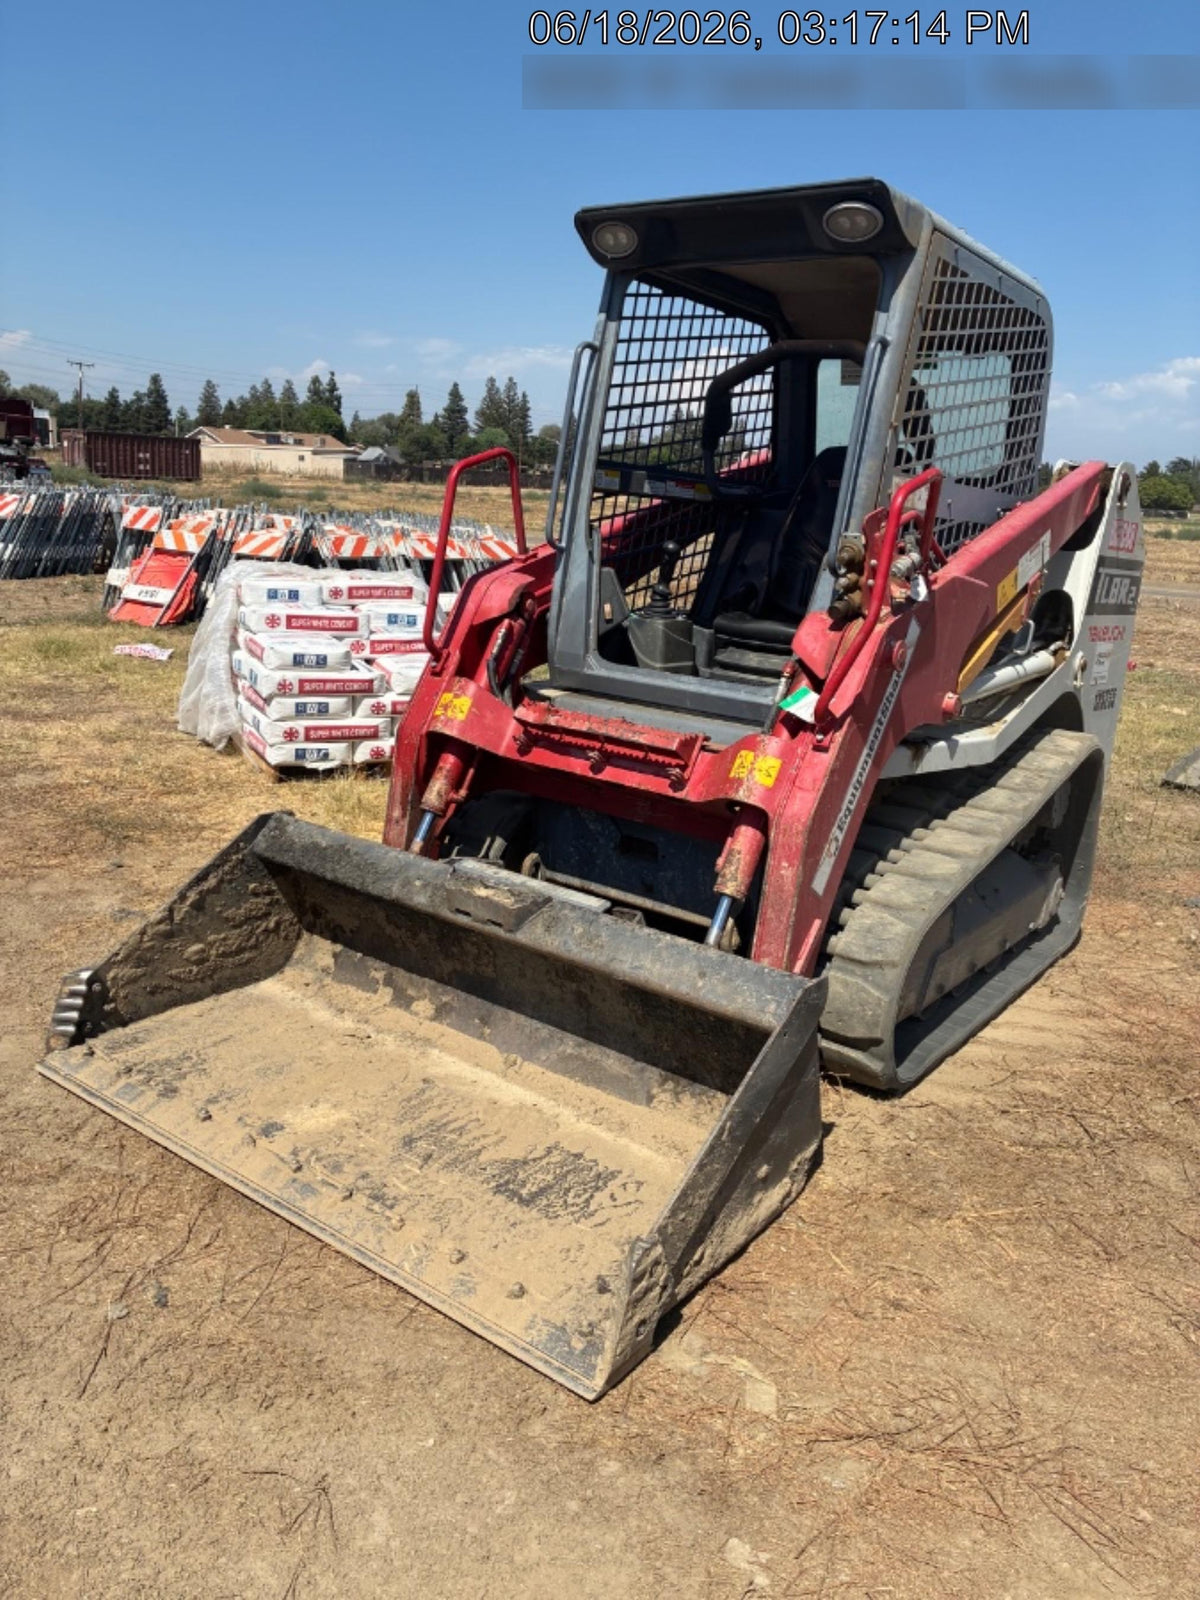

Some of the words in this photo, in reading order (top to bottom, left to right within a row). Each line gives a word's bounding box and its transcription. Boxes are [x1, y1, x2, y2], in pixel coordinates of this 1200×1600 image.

[291, 618, 310, 627] SUPER
[310, 619, 331, 628] WHITE
[331, 620, 354, 628] CEMENT
[303, 682, 324, 691] SUPER
[324, 682, 344, 691] WHITE
[344, 682, 369, 690] CEMENT
[310, 730, 330, 739] SUPER
[350, 728, 375, 737] CEMENT
[836, 670, 904, 833] EquipmentShar
